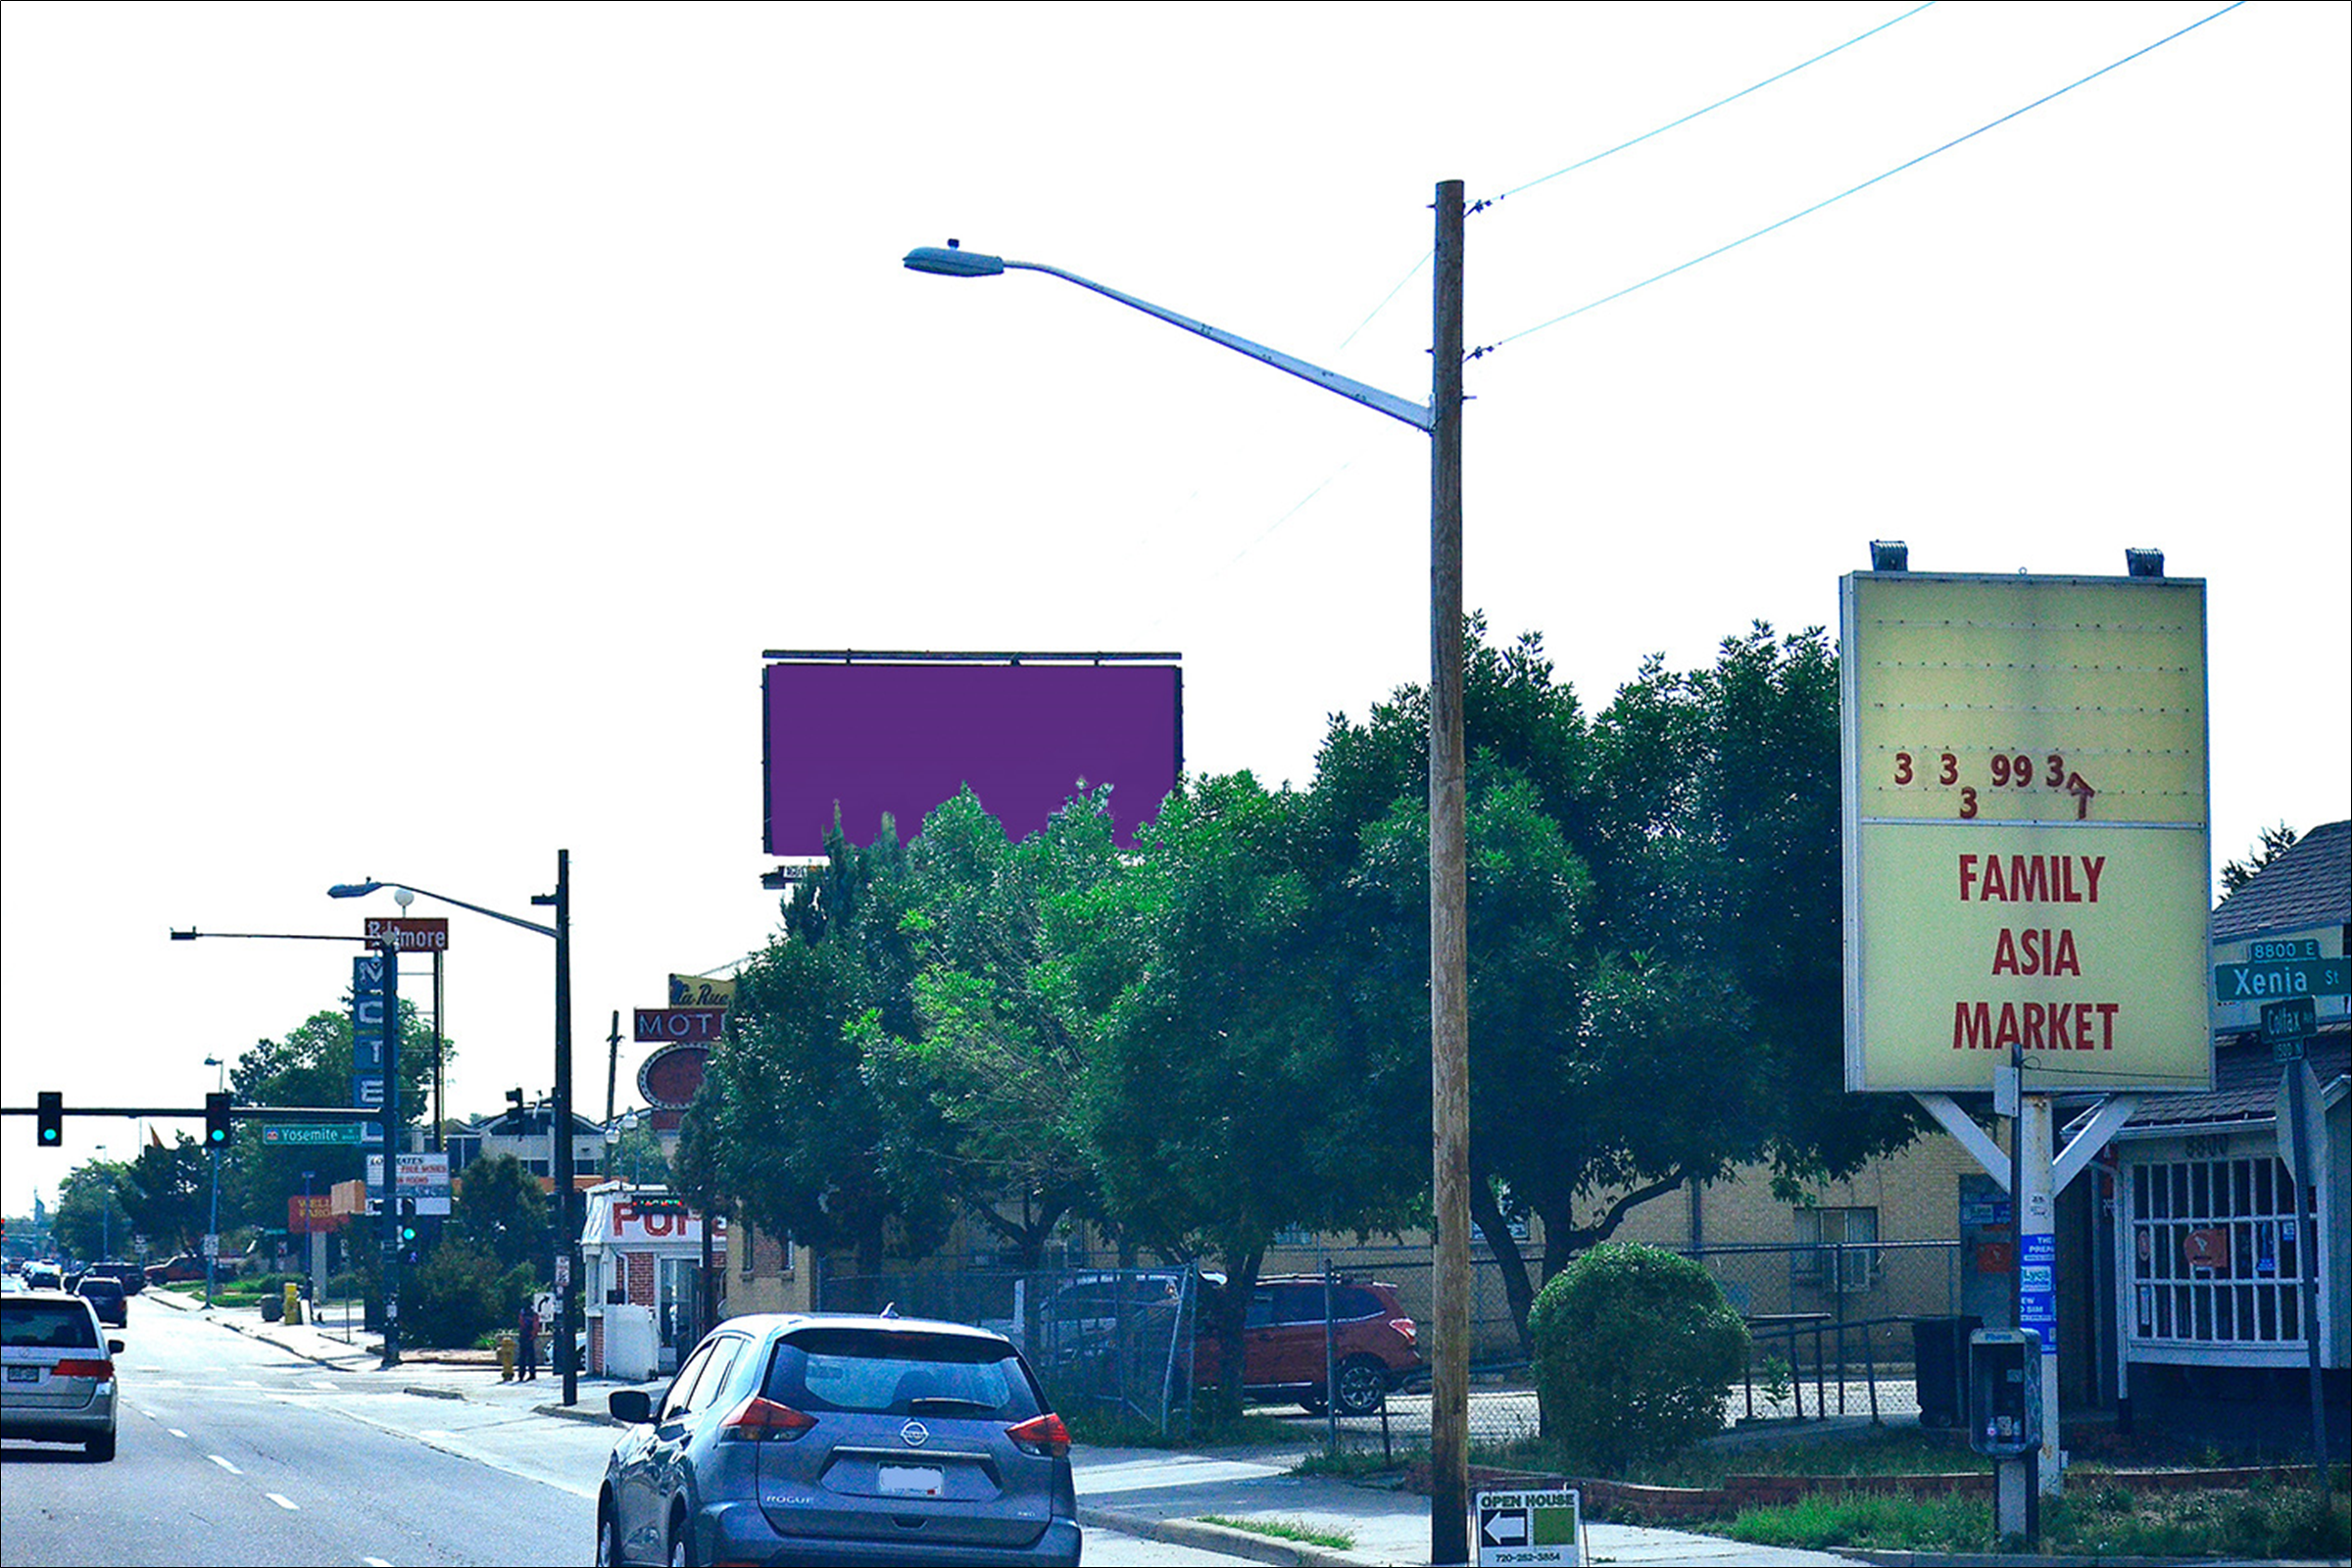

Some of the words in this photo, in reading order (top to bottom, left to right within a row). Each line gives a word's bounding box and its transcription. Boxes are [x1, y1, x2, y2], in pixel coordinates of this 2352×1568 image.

[1894, 752, 1913, 785] 3
[1939, 753, 1958, 785] 3
[2045, 755, 2065, 787] 3
[1960, 786, 1978, 818] 3
[1959, 854, 2106, 903] FAMILY
[1991, 928, 2081, 976] ASIA
[2254, 942, 2296, 959] 8800
[2305, 942, 2315, 956] E
[697, 983, 728, 1005] Rue
[2233, 965, 2308, 996] Xenia
[2324, 969, 2339, 986] St
[638, 1013, 726, 1037] MOT
[1952, 1002, 2119, 1051] MARKET
[2268, 1007, 2301, 1035] Colfax
[281, 1128, 338, 1142] Yosemite
[2023, 1268, 2050, 1282] Lyca
[1481, 1494, 1522, 1507] OPEN
[1525, 1494, 1575, 1506] HOUSE
